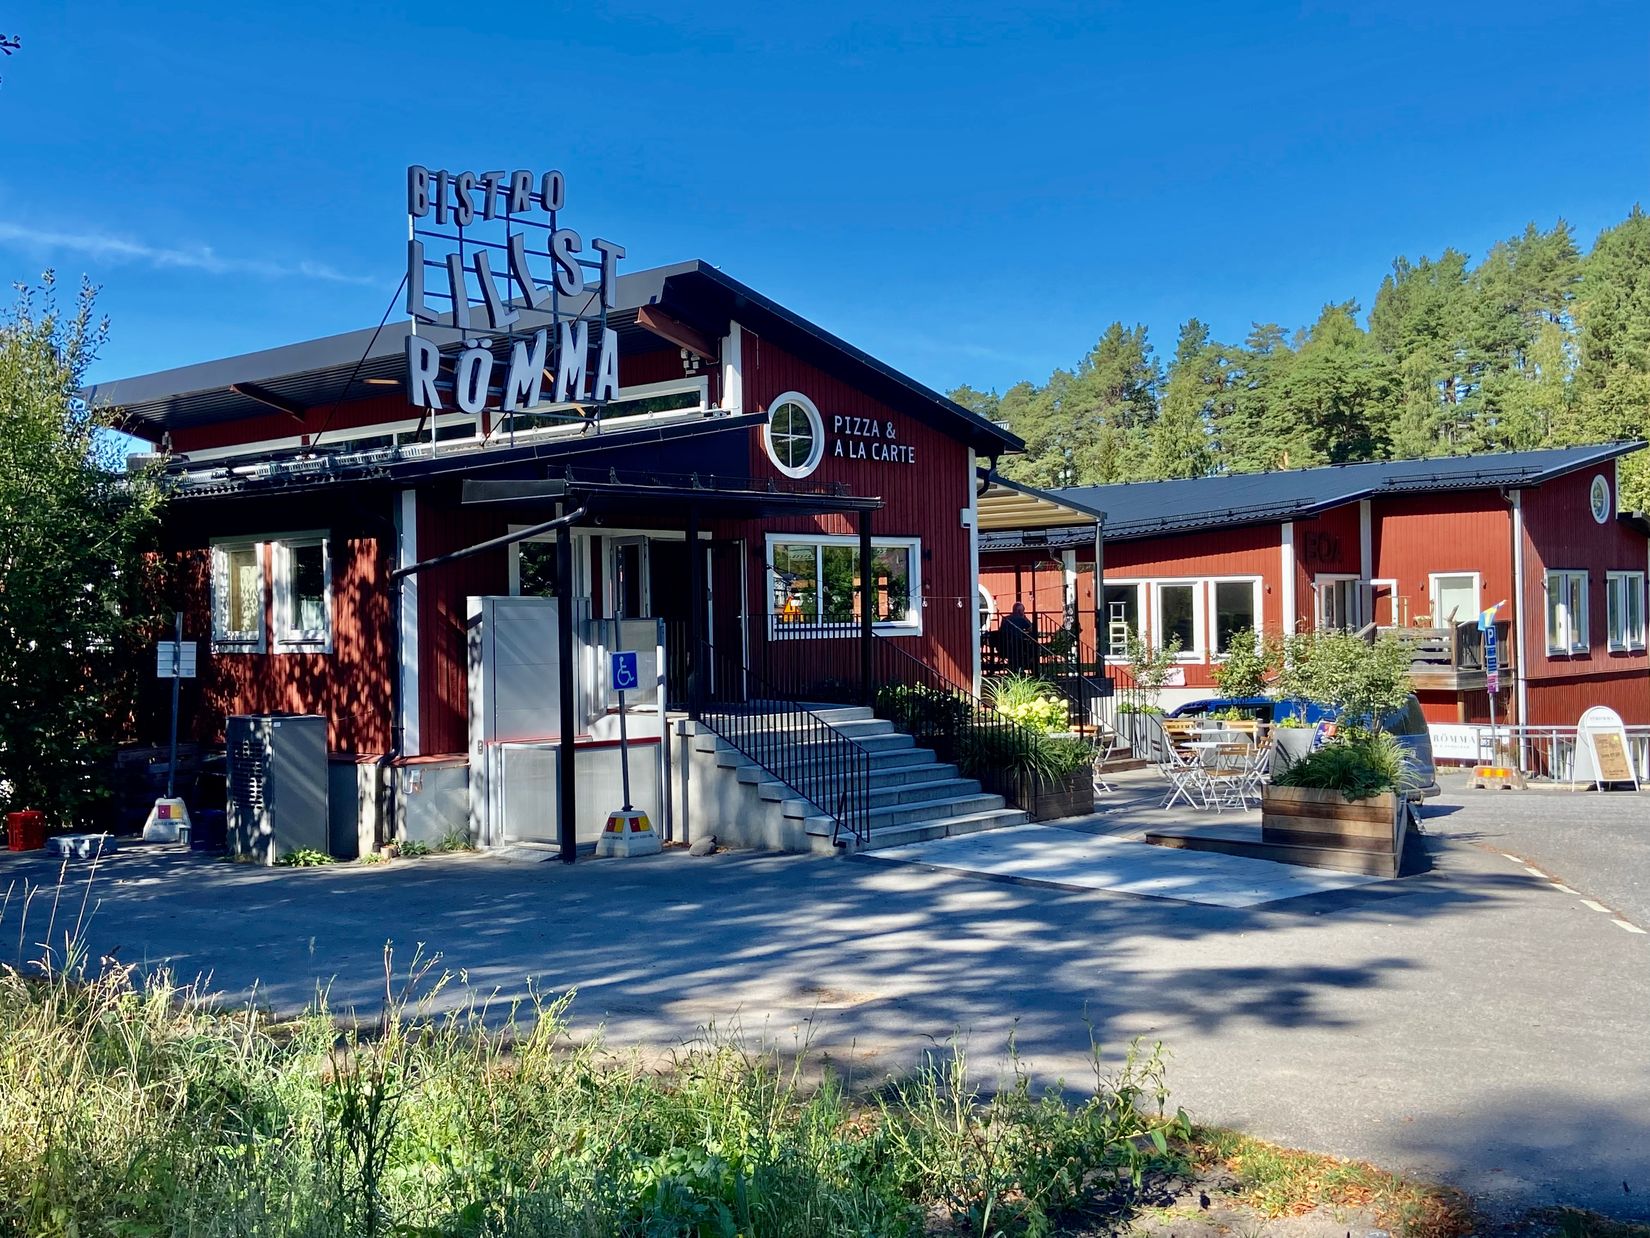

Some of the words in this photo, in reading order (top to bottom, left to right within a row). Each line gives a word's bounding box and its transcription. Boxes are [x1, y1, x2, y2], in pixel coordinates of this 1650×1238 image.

[408, 165, 565, 226] BISTRO
[406, 228, 626, 329] LILLST
[405, 321, 620, 414] RÖMMA
[834, 415, 880, 437] PIZZA
[886, 421, 896, 440] &
[834, 439, 844, 457] A
[849, 441, 867, 460] LA
[872, 442, 916, 464] CARTE
[1487, 628, 1494, 645] P
